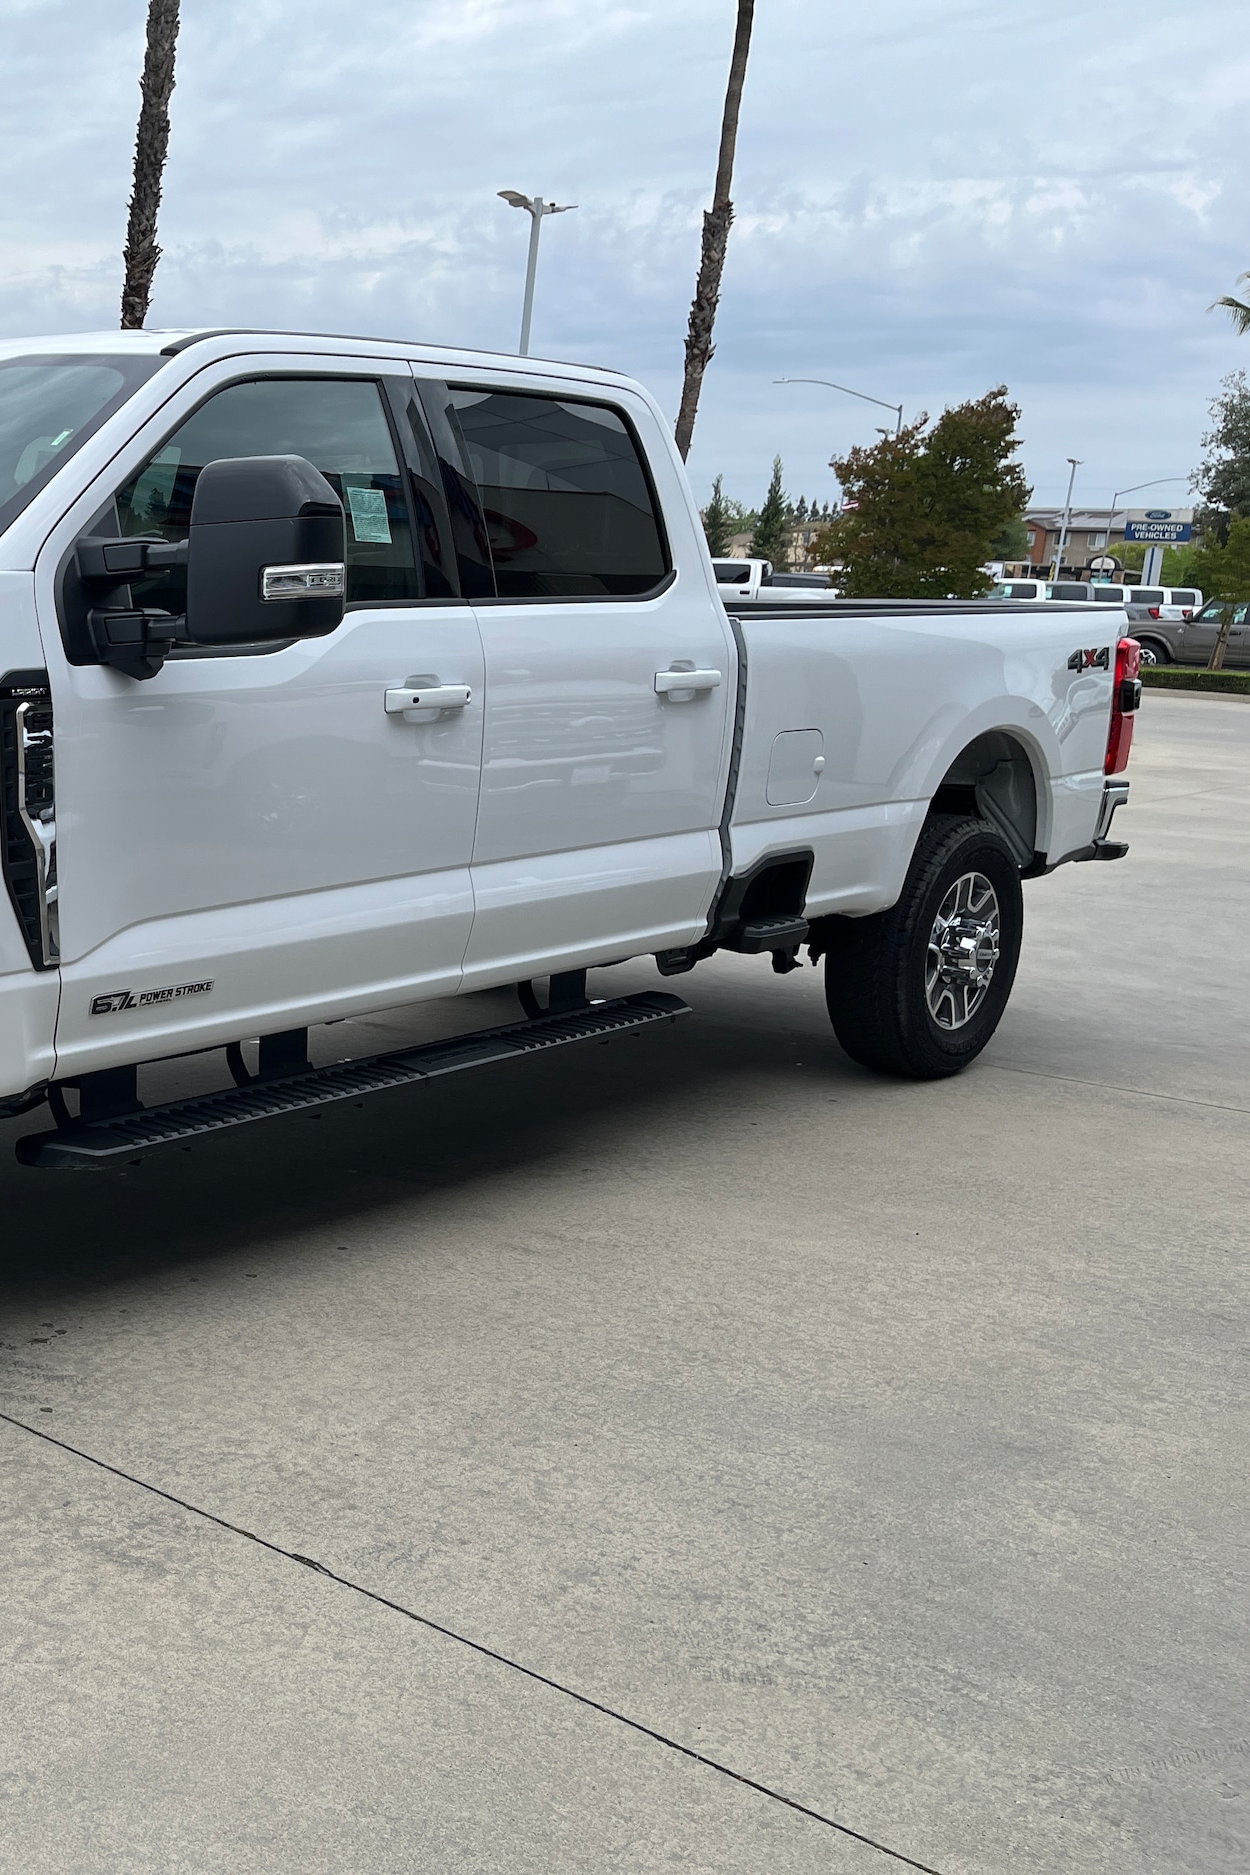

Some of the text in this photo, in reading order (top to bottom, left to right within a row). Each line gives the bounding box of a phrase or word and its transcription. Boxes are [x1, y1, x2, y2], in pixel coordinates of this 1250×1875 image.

[1131, 523, 1184, 532] PRE-OWNED
[1134, 531, 1177, 540] VEHICLES
[90, 990, 138, 1015] 6.7L
[139, 988, 174, 1004] POWER
[175, 981, 214, 997] STROKE
